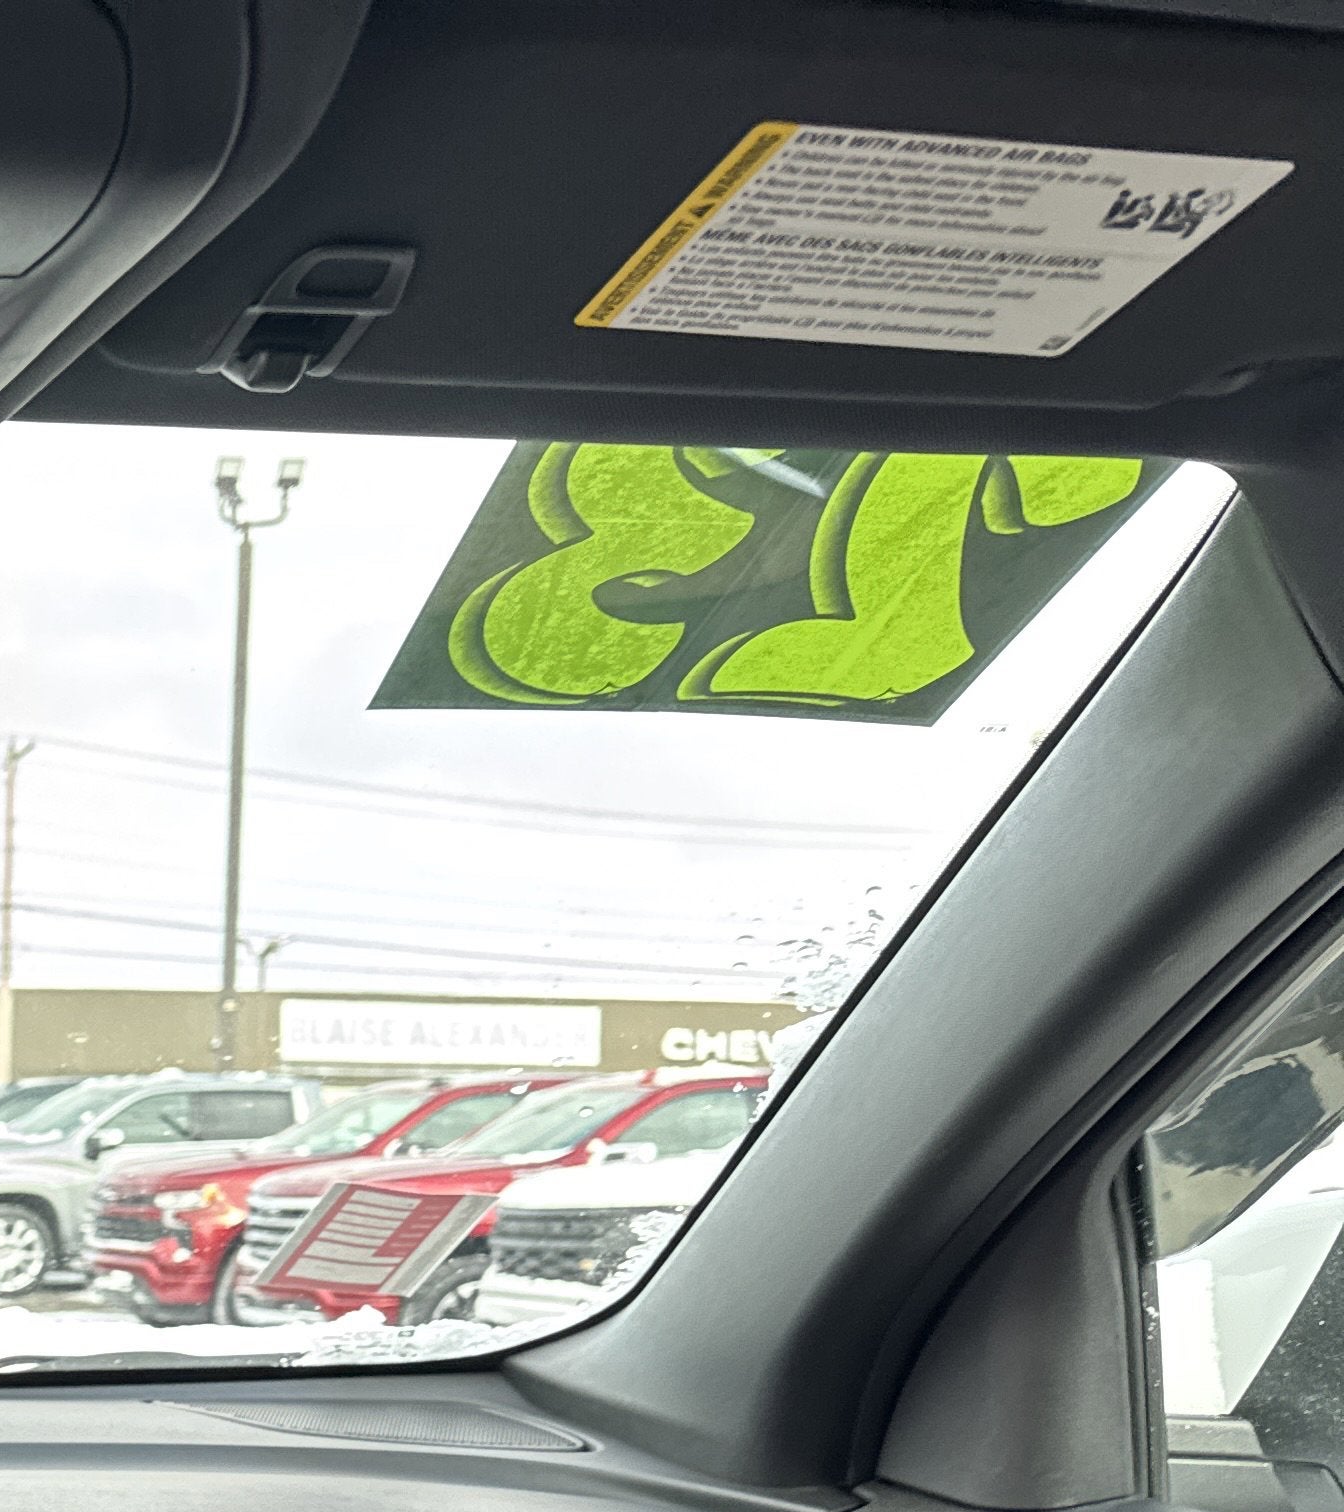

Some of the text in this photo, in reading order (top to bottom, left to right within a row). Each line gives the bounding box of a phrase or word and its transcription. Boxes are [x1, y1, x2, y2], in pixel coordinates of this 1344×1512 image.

[794, 132, 1092, 166] EVEN WITH ADVANCED AIR BAGS
[755, 232, 799, 247] AVEC
[290, 1015, 395, 1048] BLAISE
